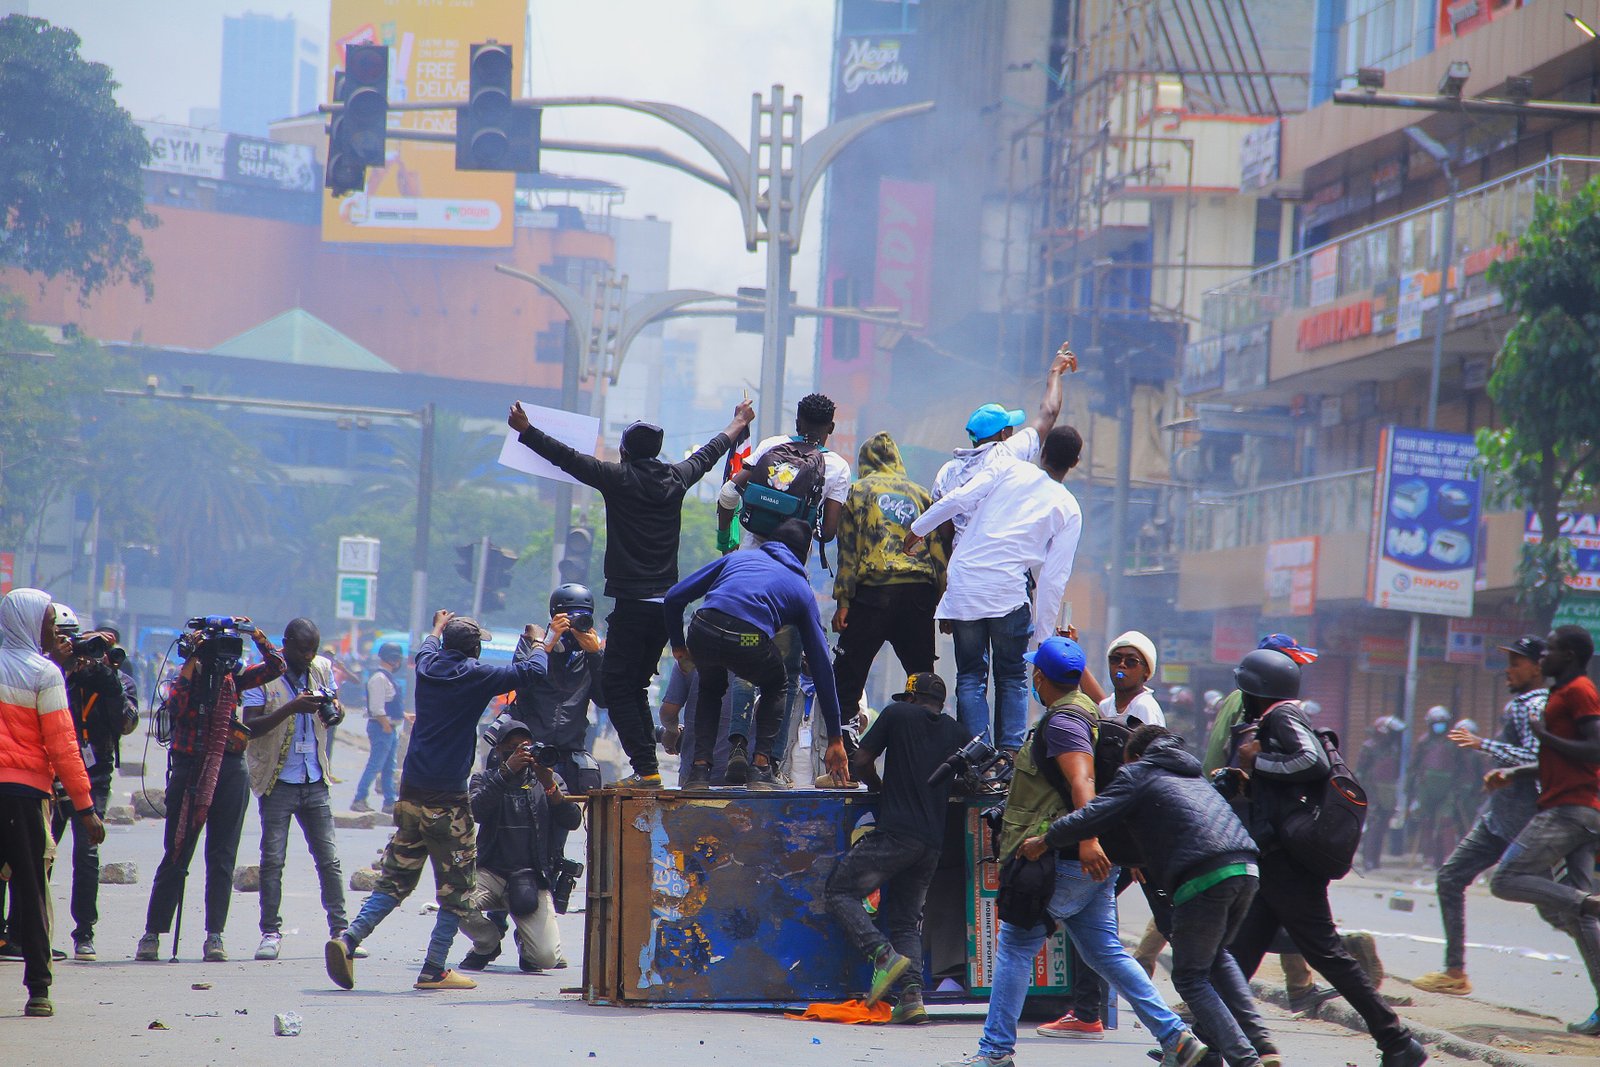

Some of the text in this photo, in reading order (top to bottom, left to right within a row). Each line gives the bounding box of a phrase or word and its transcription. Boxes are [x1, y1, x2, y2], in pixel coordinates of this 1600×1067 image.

[416, 62, 456, 80] FREE
[843, 63, 909, 93] Growth
[416, 80, 470, 97] DELIVE
[1457, 444, 1479, 457] SHO
[1053, 932, 1064, 985] PESA
